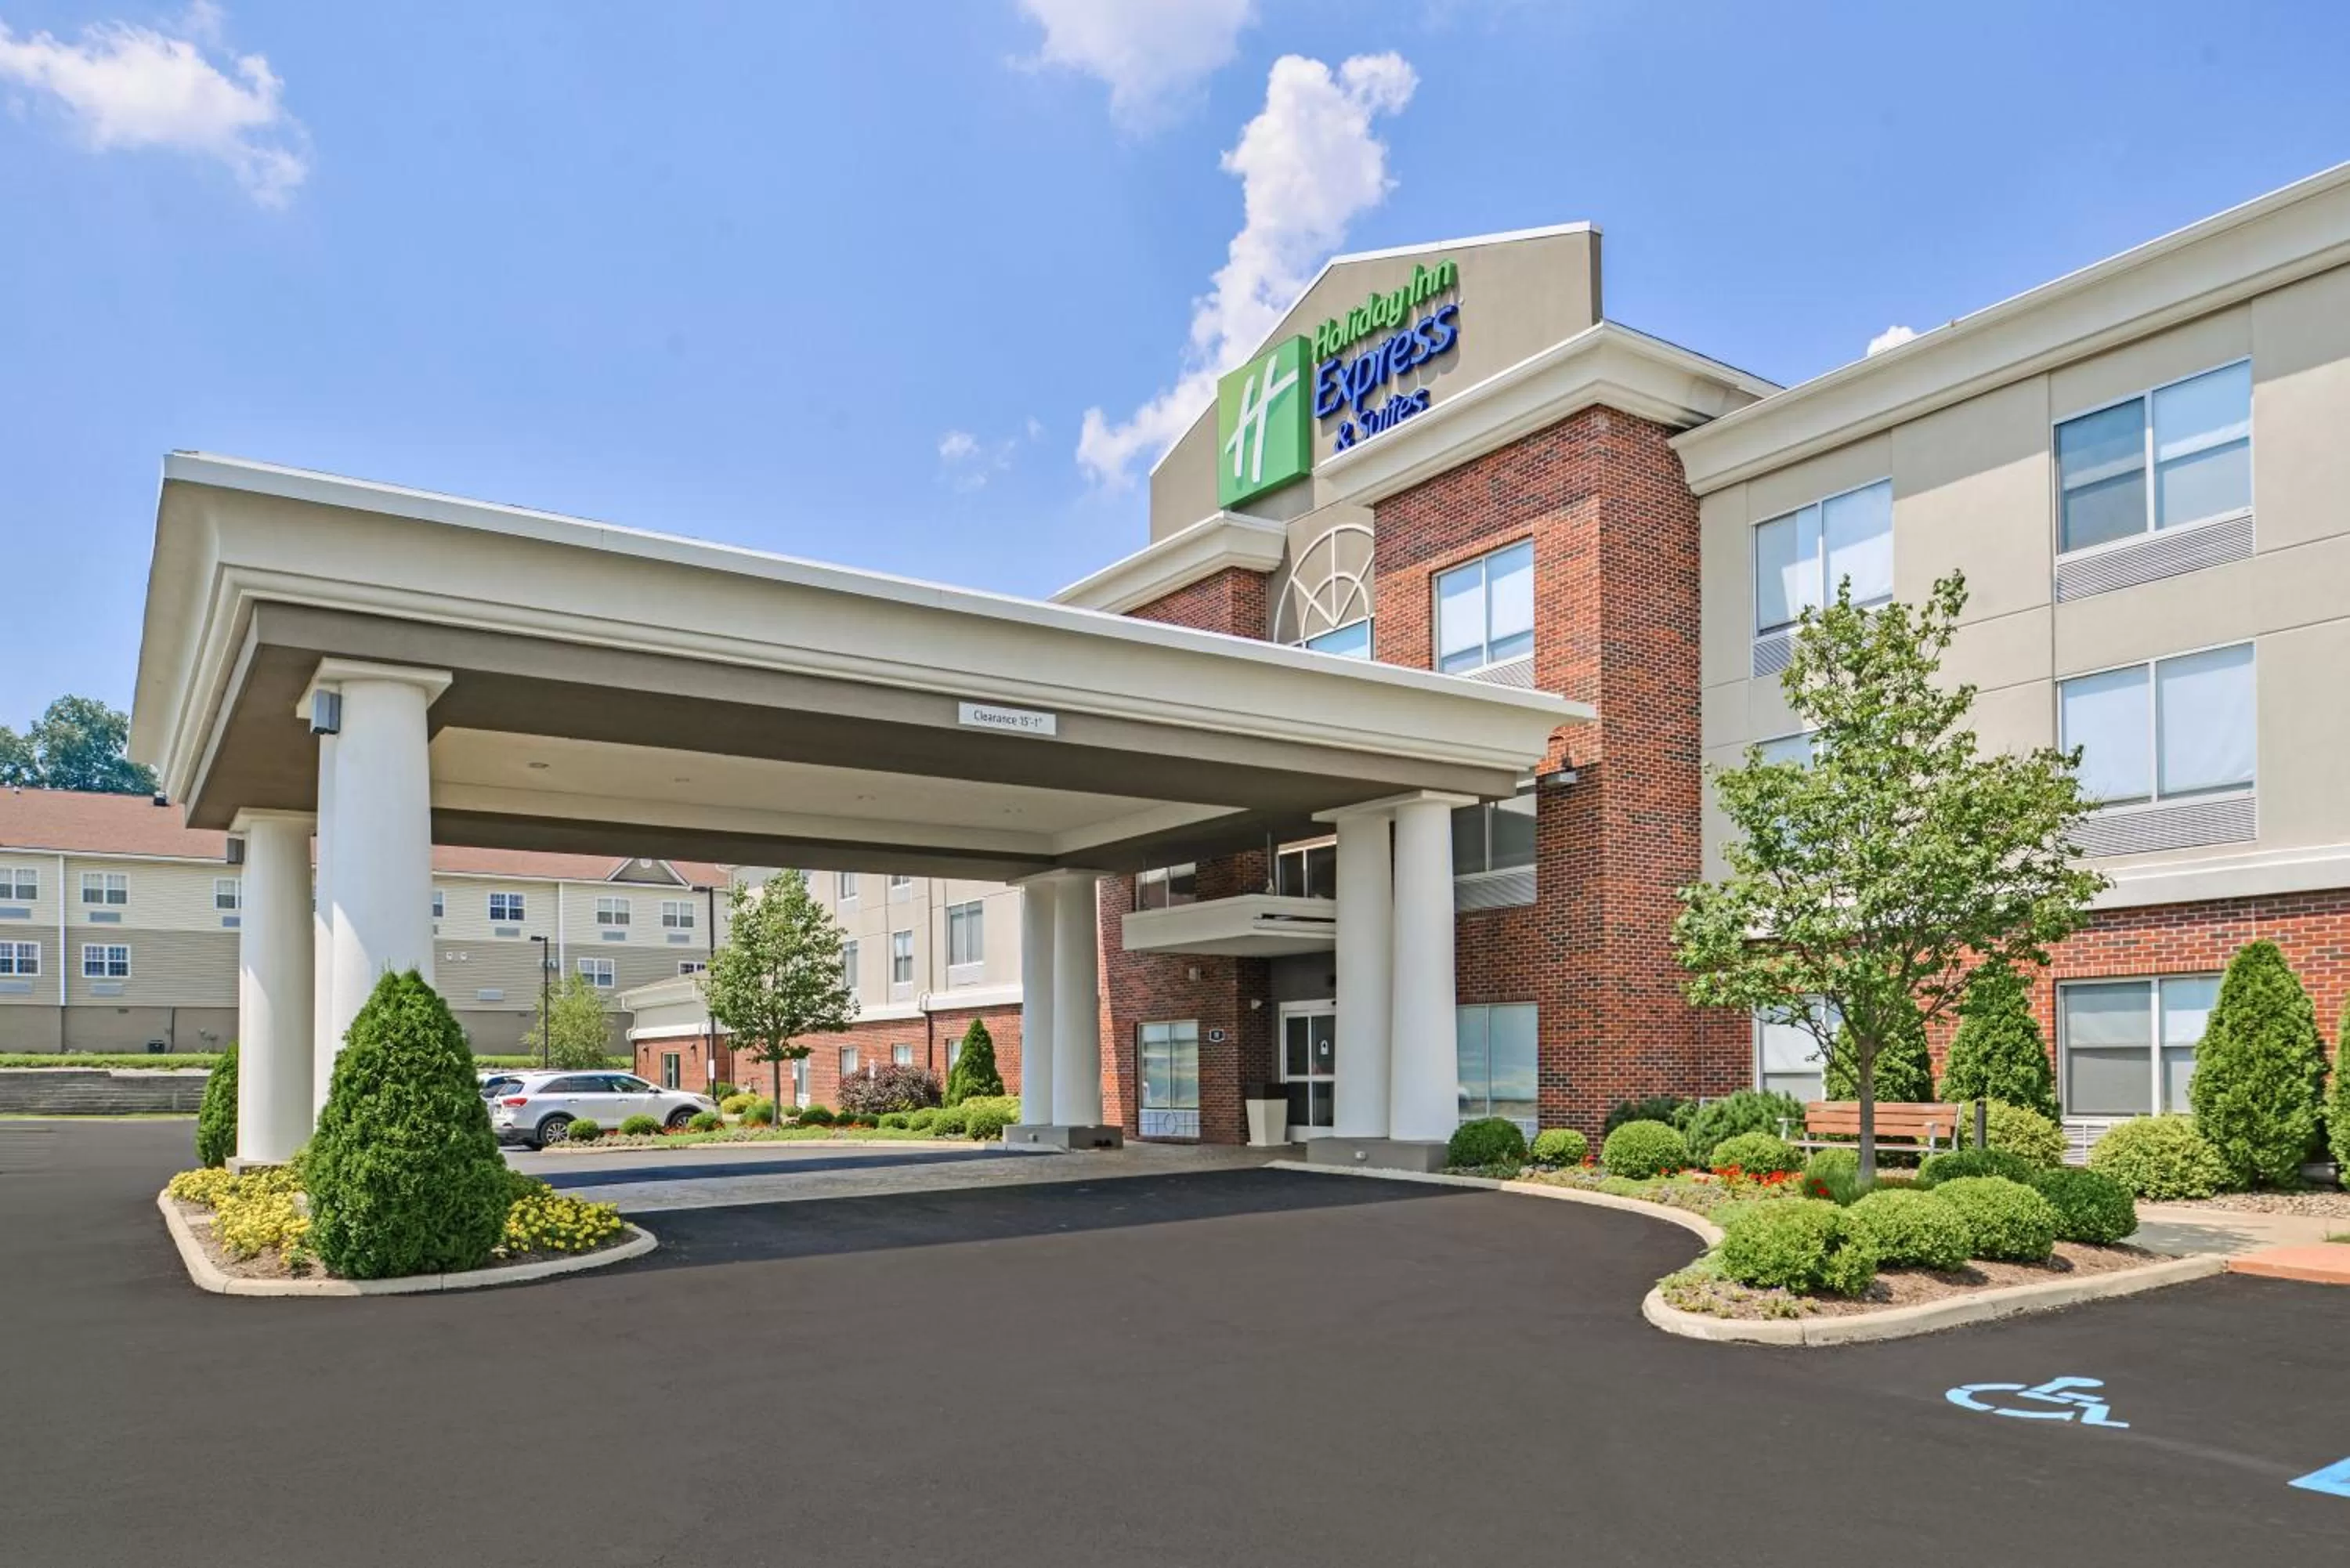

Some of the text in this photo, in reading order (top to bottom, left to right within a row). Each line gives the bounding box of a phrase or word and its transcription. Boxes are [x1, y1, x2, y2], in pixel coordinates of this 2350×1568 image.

[1312, 258, 1458, 364] Holiday Inn
[1314, 305, 1459, 418] Express
[1334, 388, 1431, 452] & Suites
[974, 710, 1017, 725] Clearance
